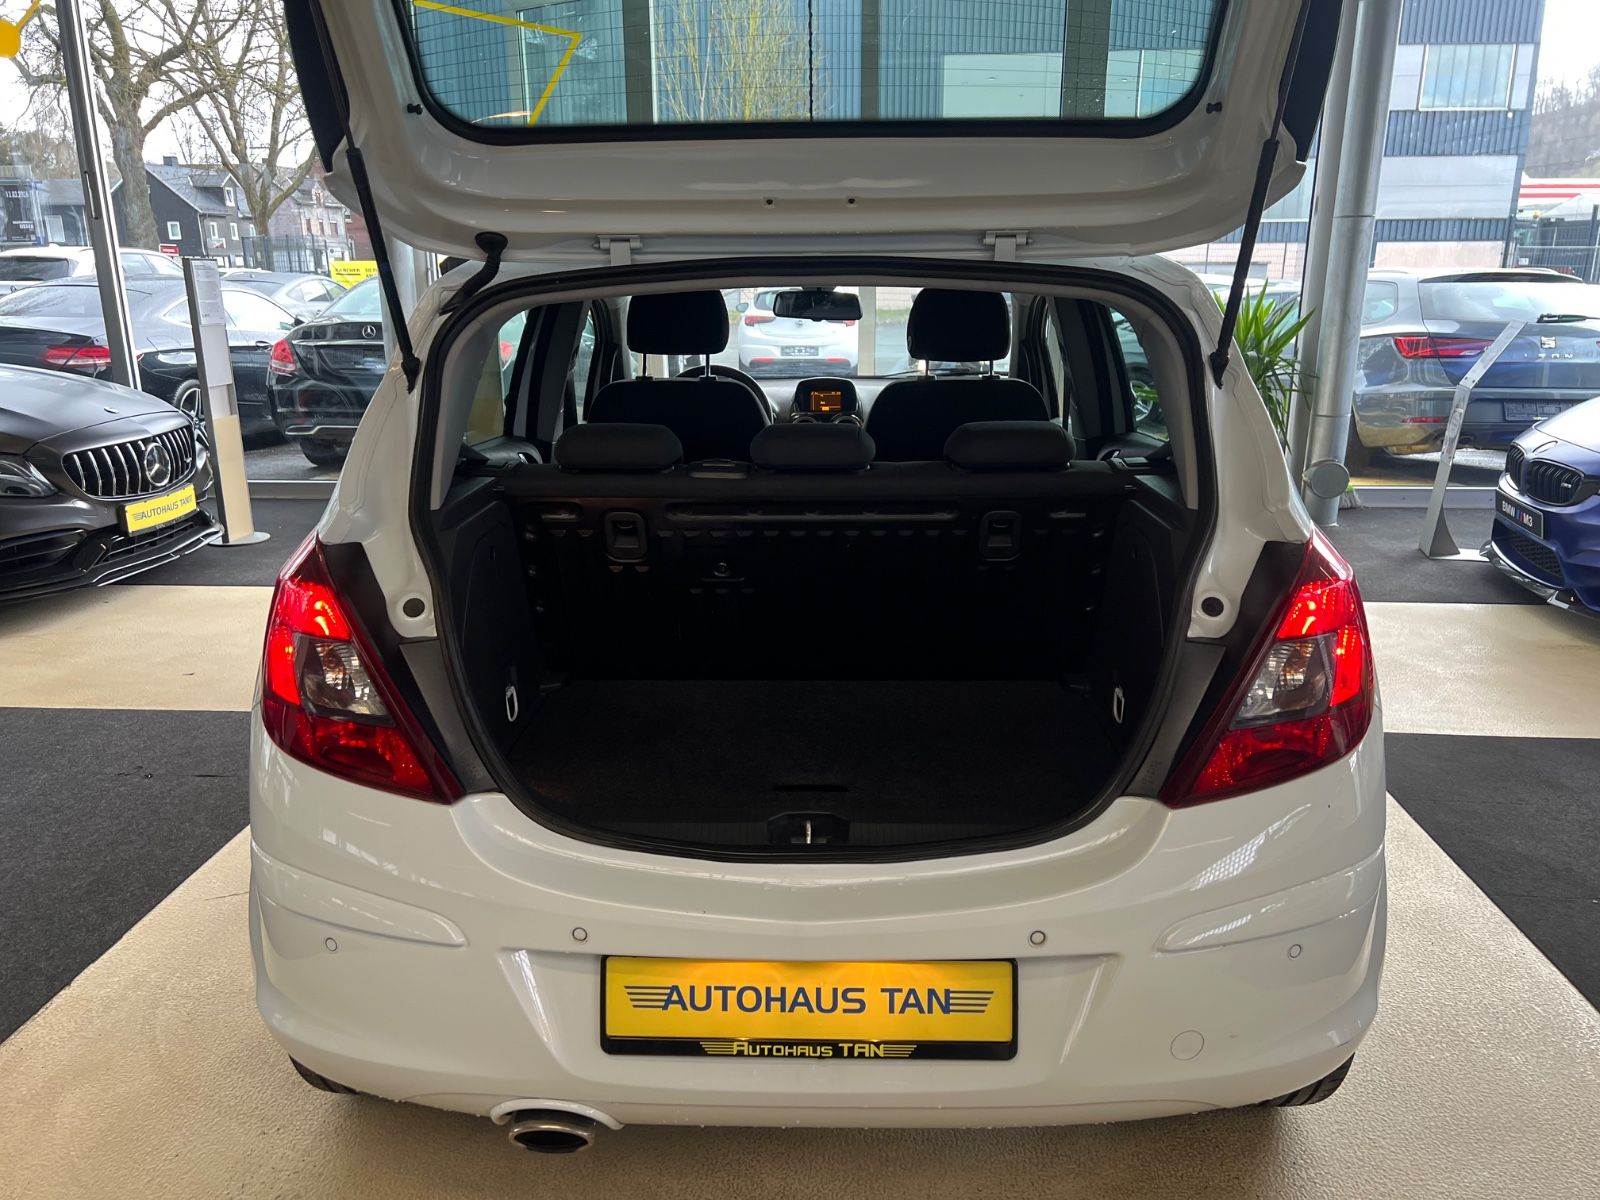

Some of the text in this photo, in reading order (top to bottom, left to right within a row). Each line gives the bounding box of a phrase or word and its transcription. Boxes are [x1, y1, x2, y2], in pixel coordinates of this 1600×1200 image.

[141, 501, 179, 519] AUTOHAUS
[1502, 500, 1516, 518] BMW
[662, 985, 951, 1015] AUTOHAUS TAN
[838, 1043, 885, 1058] TAN
